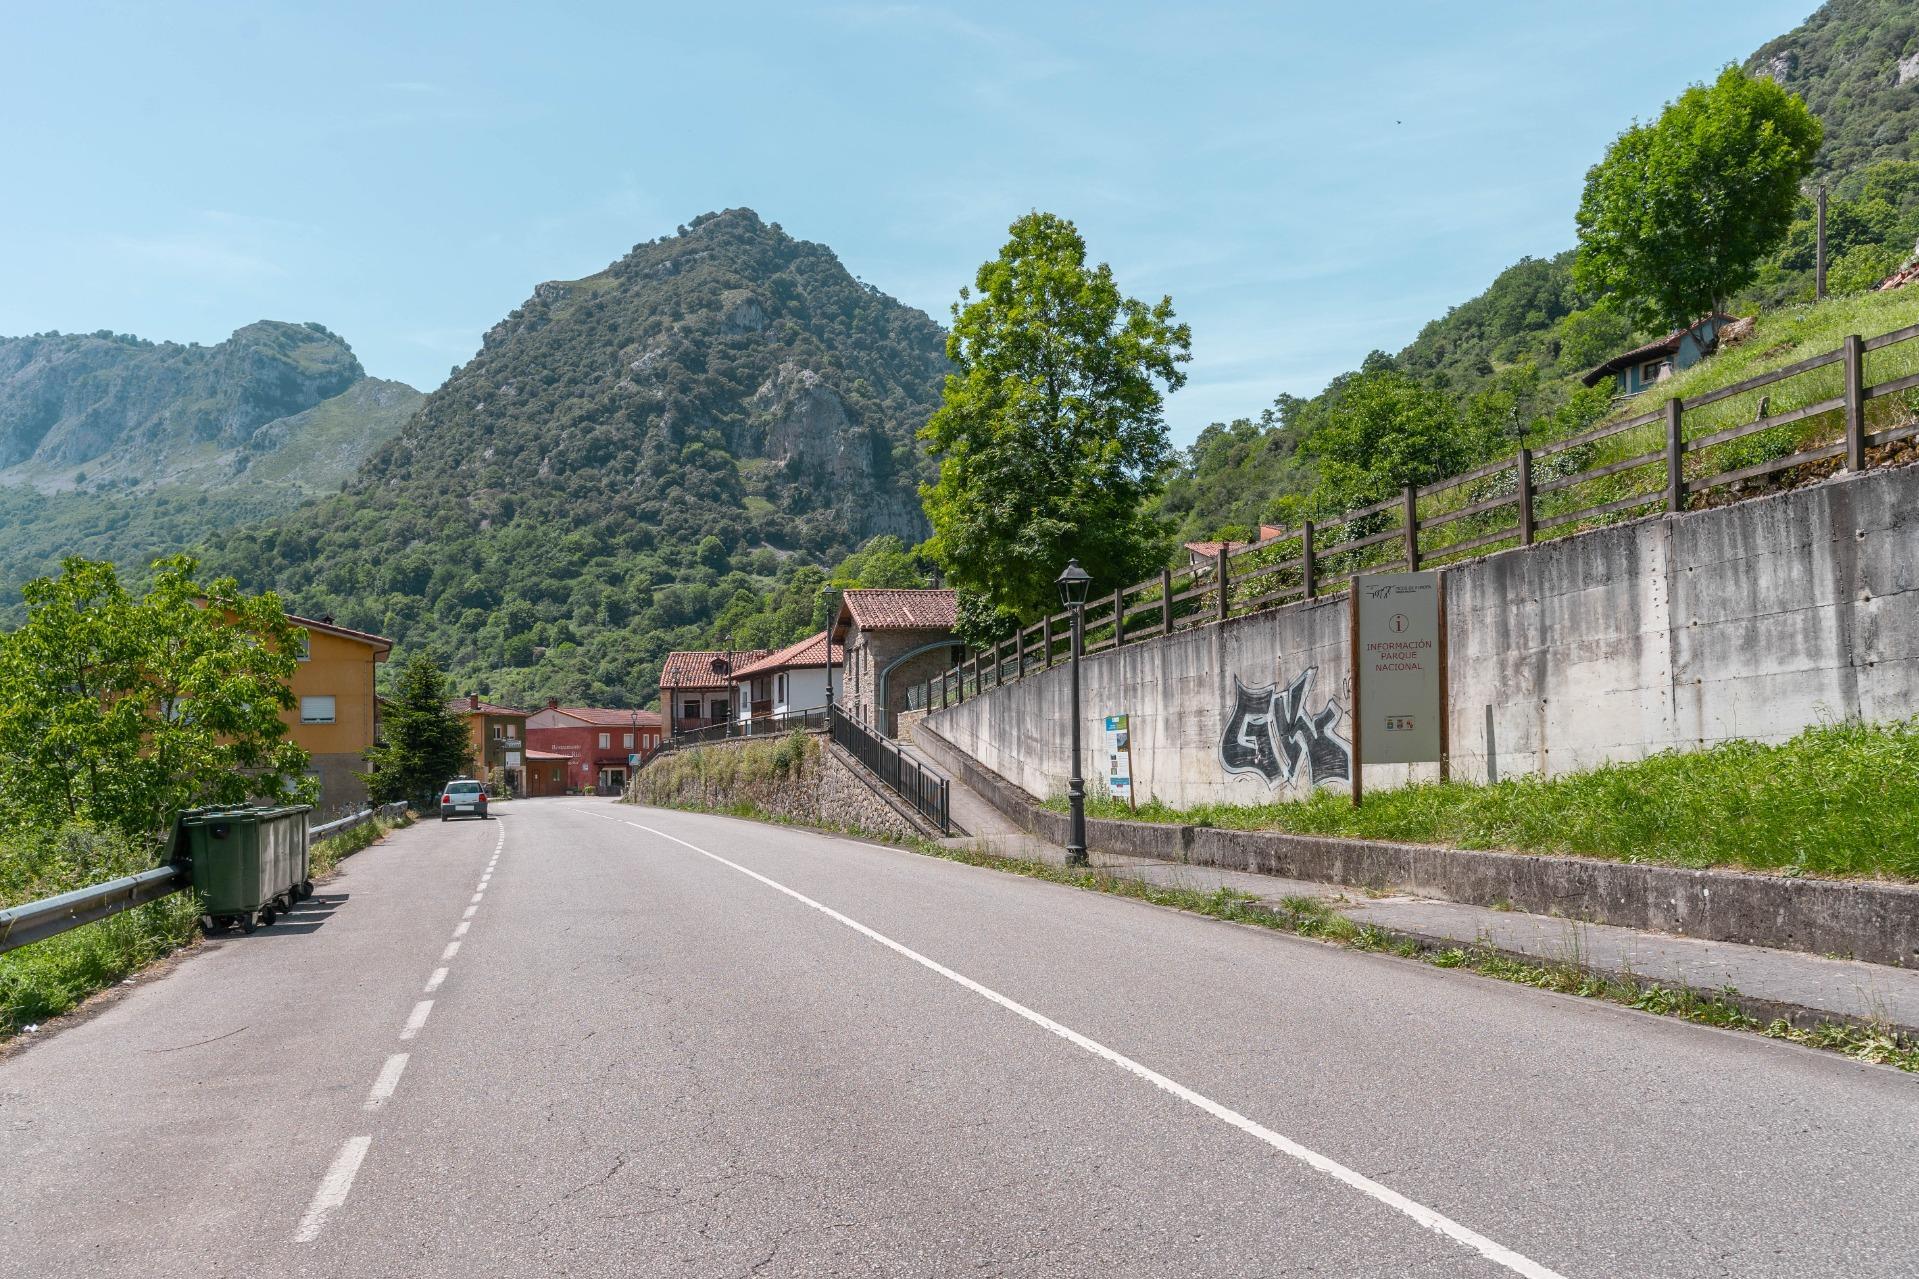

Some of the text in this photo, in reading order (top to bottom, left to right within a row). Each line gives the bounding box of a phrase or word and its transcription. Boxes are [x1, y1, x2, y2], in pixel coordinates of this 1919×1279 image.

[1367, 639, 1432, 650] INFORMACIÓN
[1381, 651, 1417, 660] PARQUE
[1375, 663, 1423, 671] NACIONAL
